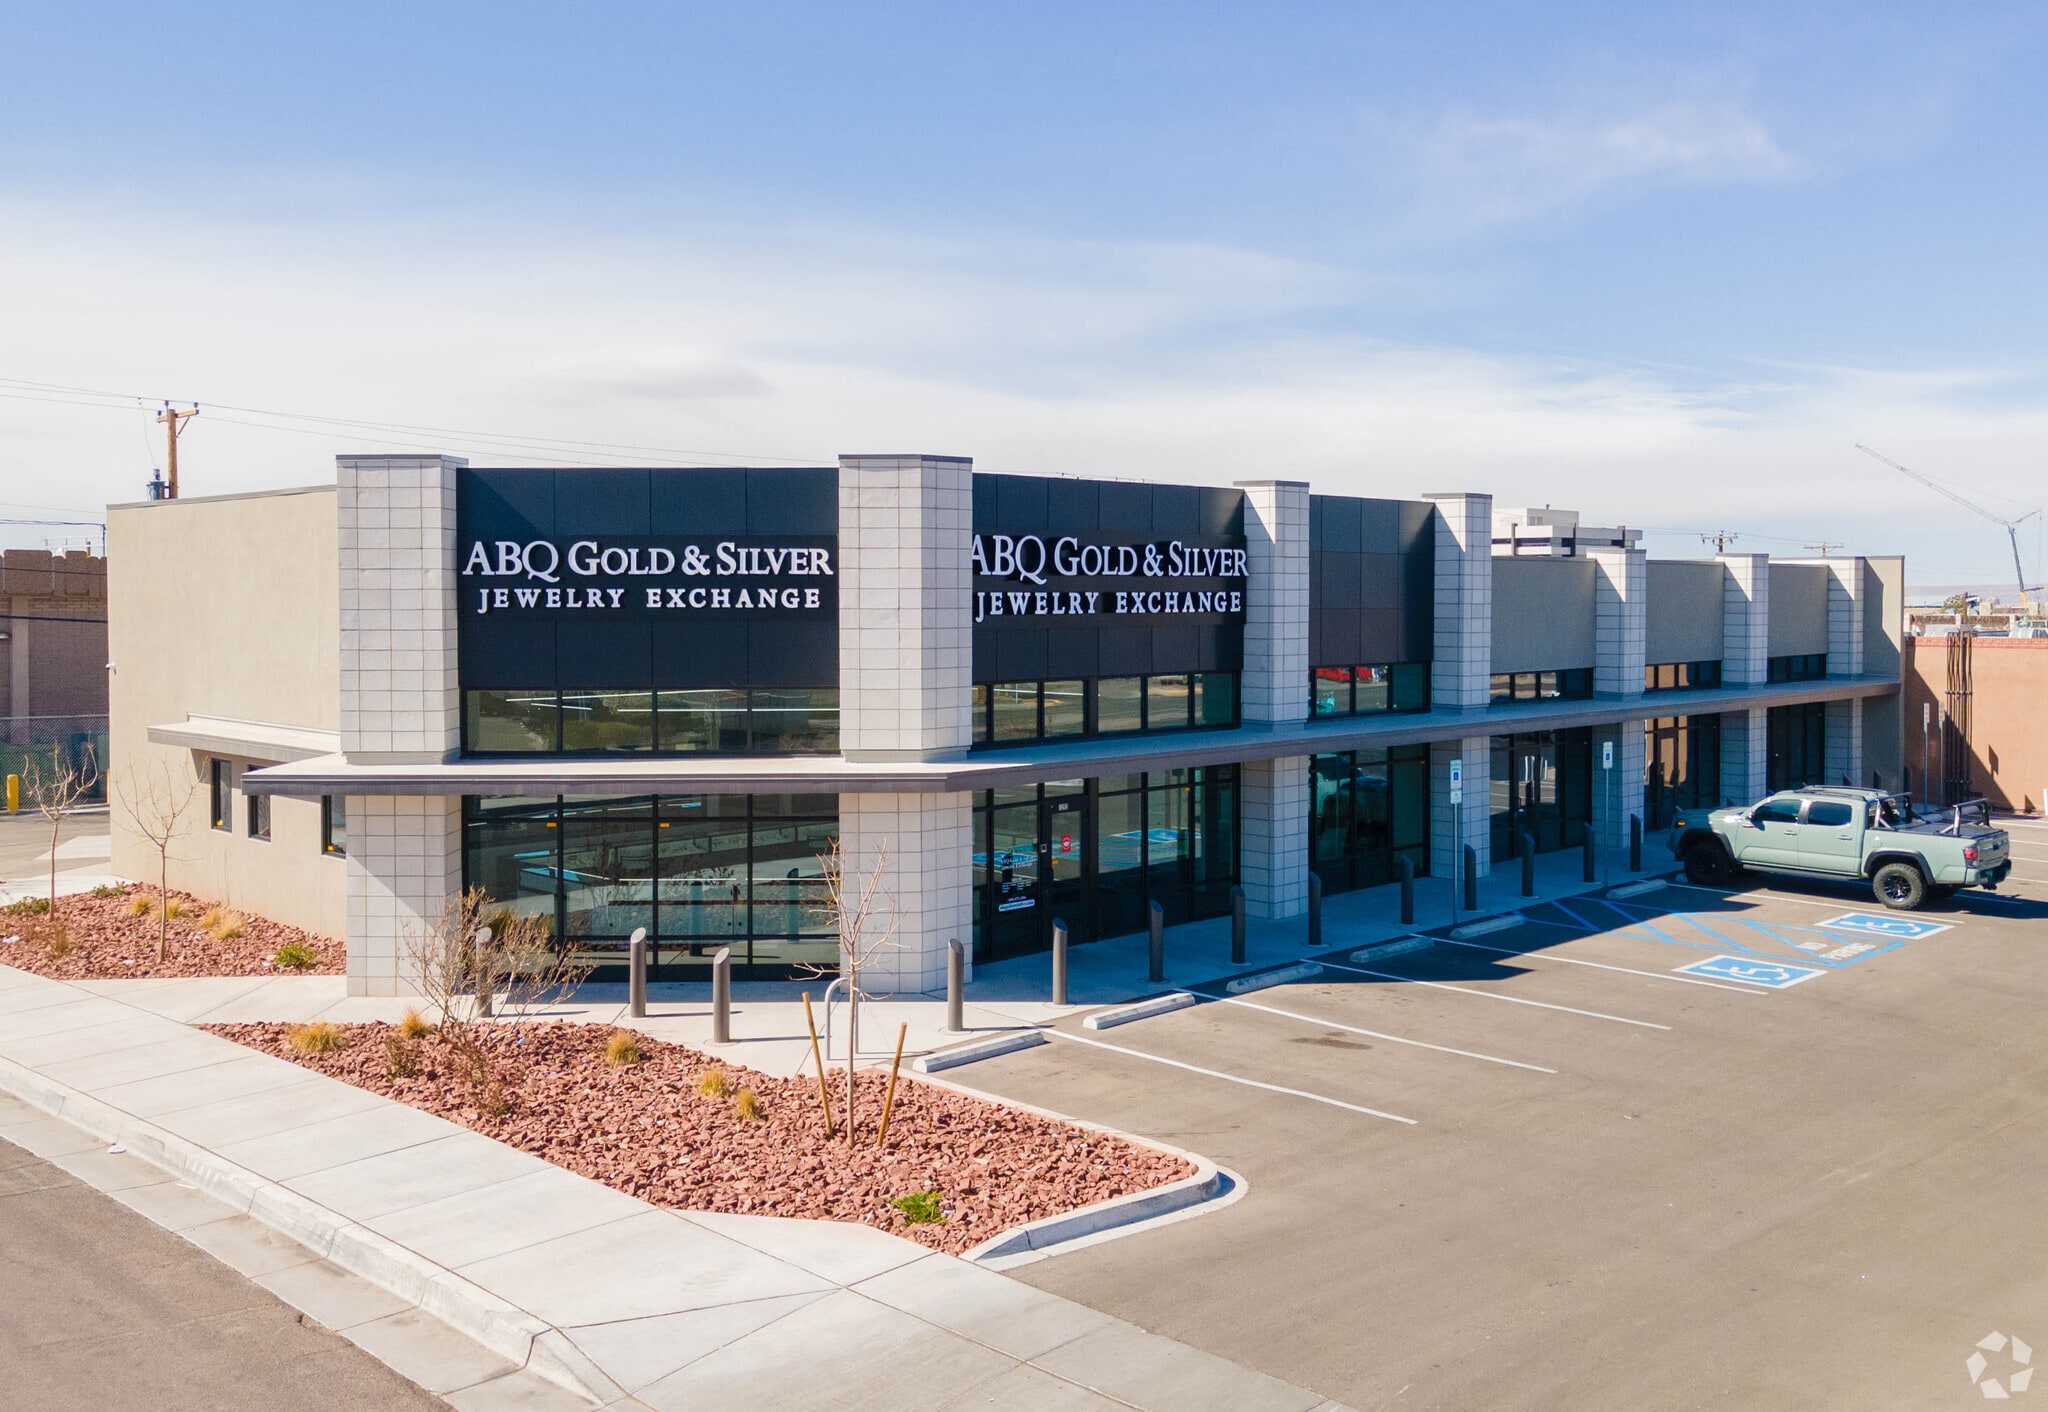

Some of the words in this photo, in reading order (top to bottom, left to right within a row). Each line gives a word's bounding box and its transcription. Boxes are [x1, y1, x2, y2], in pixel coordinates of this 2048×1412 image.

[462, 541, 560, 583] ABQ
[568, 541, 676, 576] GOLD
[682, 545, 711, 576] &
[716, 541, 834, 576] SILVER
[972, 534, 1047, 585] ABQ
[1054, 536, 1138, 577] GOLD
[1143, 543, 1164, 577] &
[1168, 540, 1250, 577] SILVER
[477, 588, 625, 614] JEWELRY
[646, 588, 820, 609] EXCHANGE
[975, 591, 1099, 623] JEWELRY
[1115, 591, 1242, 614] EXCHANGE
